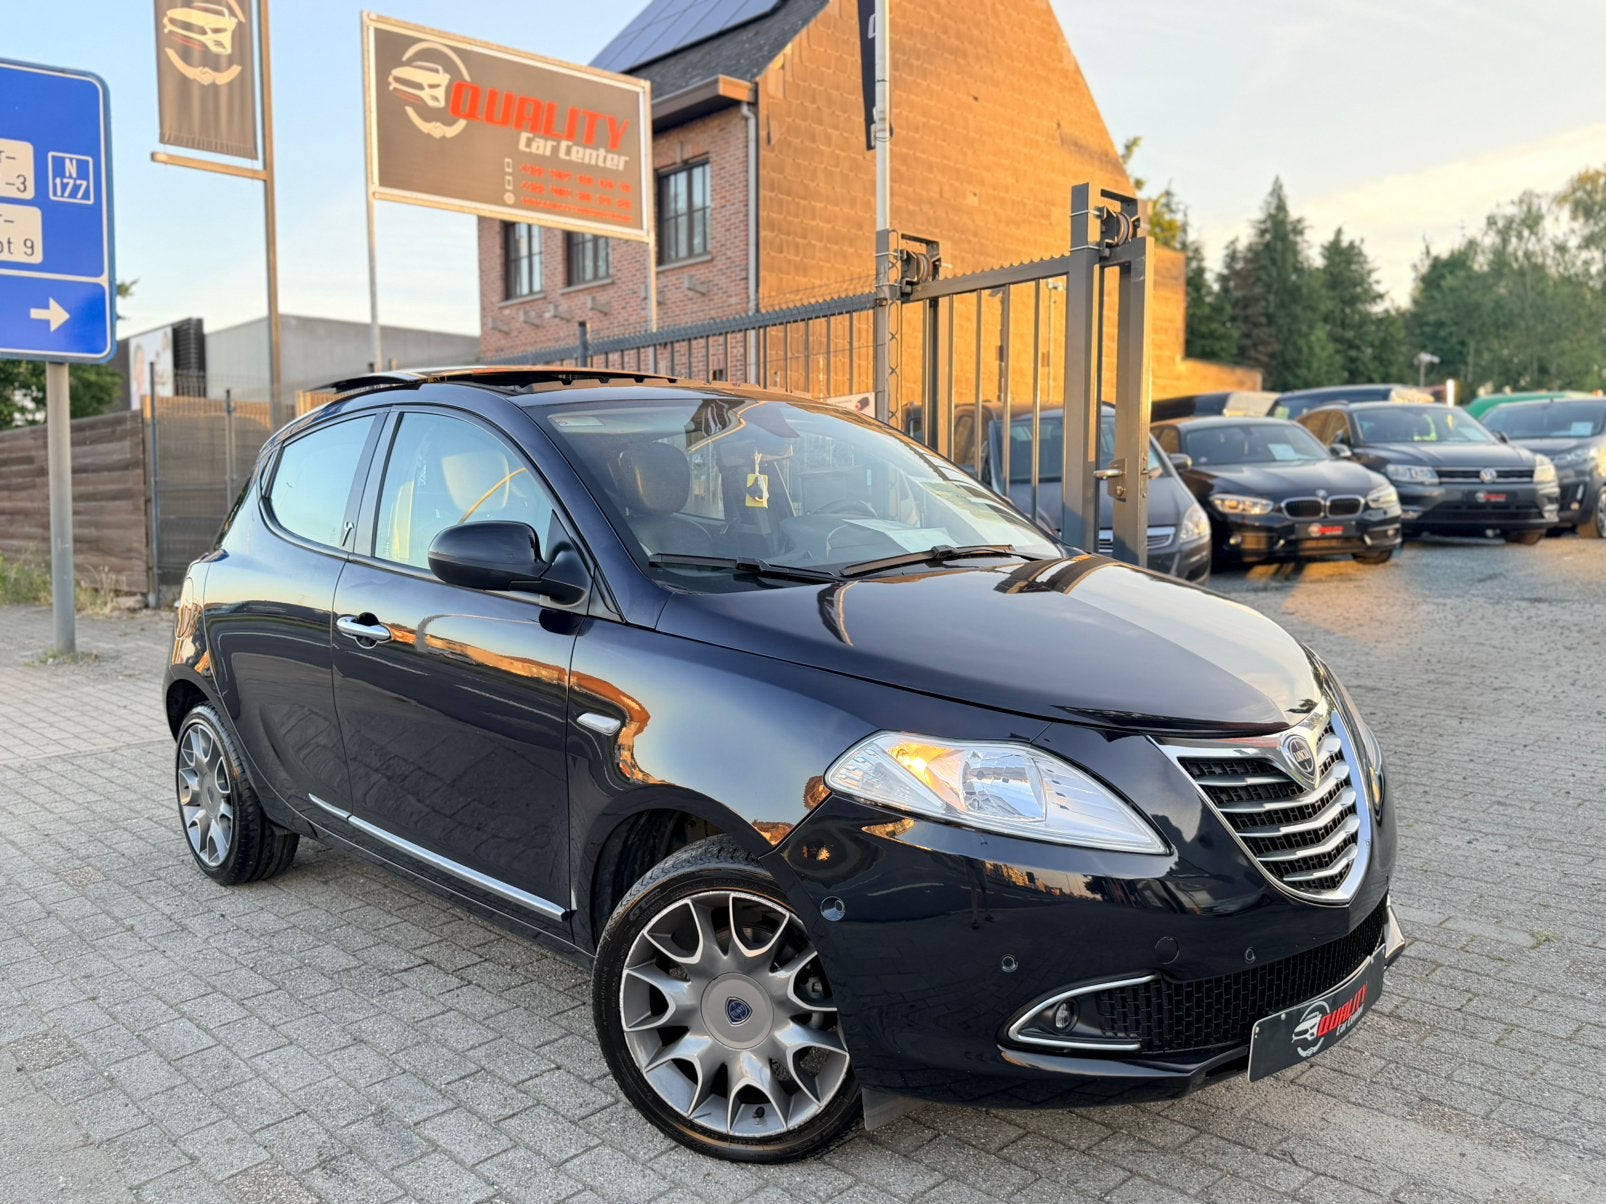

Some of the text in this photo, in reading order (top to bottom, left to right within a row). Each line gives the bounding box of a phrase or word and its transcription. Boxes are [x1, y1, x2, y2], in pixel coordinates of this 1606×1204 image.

[450, 81, 630, 150] QUALITY
[518, 131, 629, 171] Car Center
[65, 158, 77, 178] N
[55, 177, 88, 199] 177
[23, 238, 35, 257] 9
